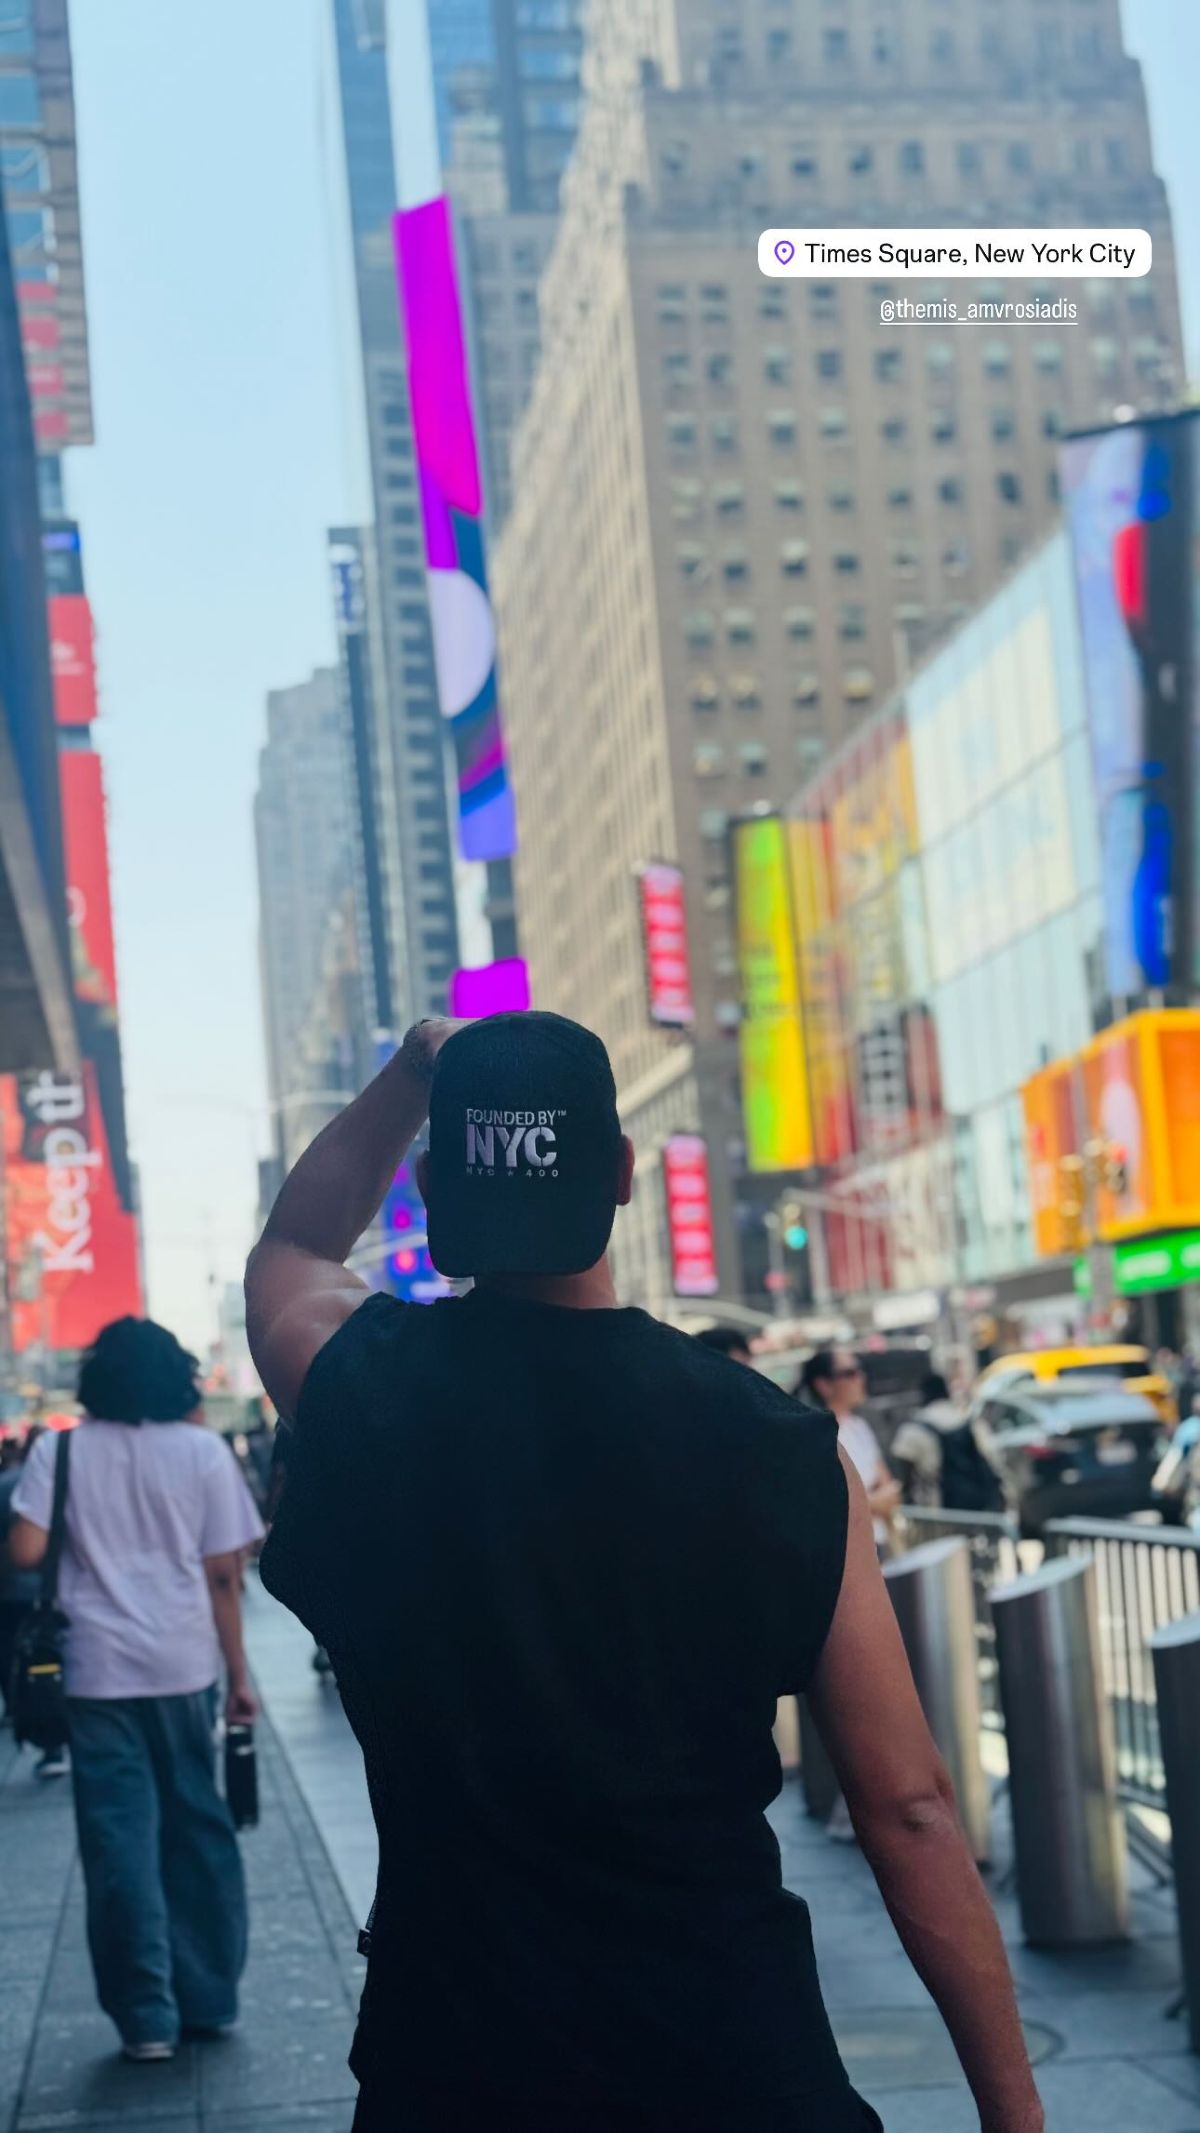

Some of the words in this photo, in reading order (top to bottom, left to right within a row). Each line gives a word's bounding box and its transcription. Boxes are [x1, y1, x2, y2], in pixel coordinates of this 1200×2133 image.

[466, 1108, 535, 1125] FOUNDED
[466, 1123, 557, 1168] NYC
[526, 1168, 559, 1177] 400
[33, 1127, 103, 1273] Keep
